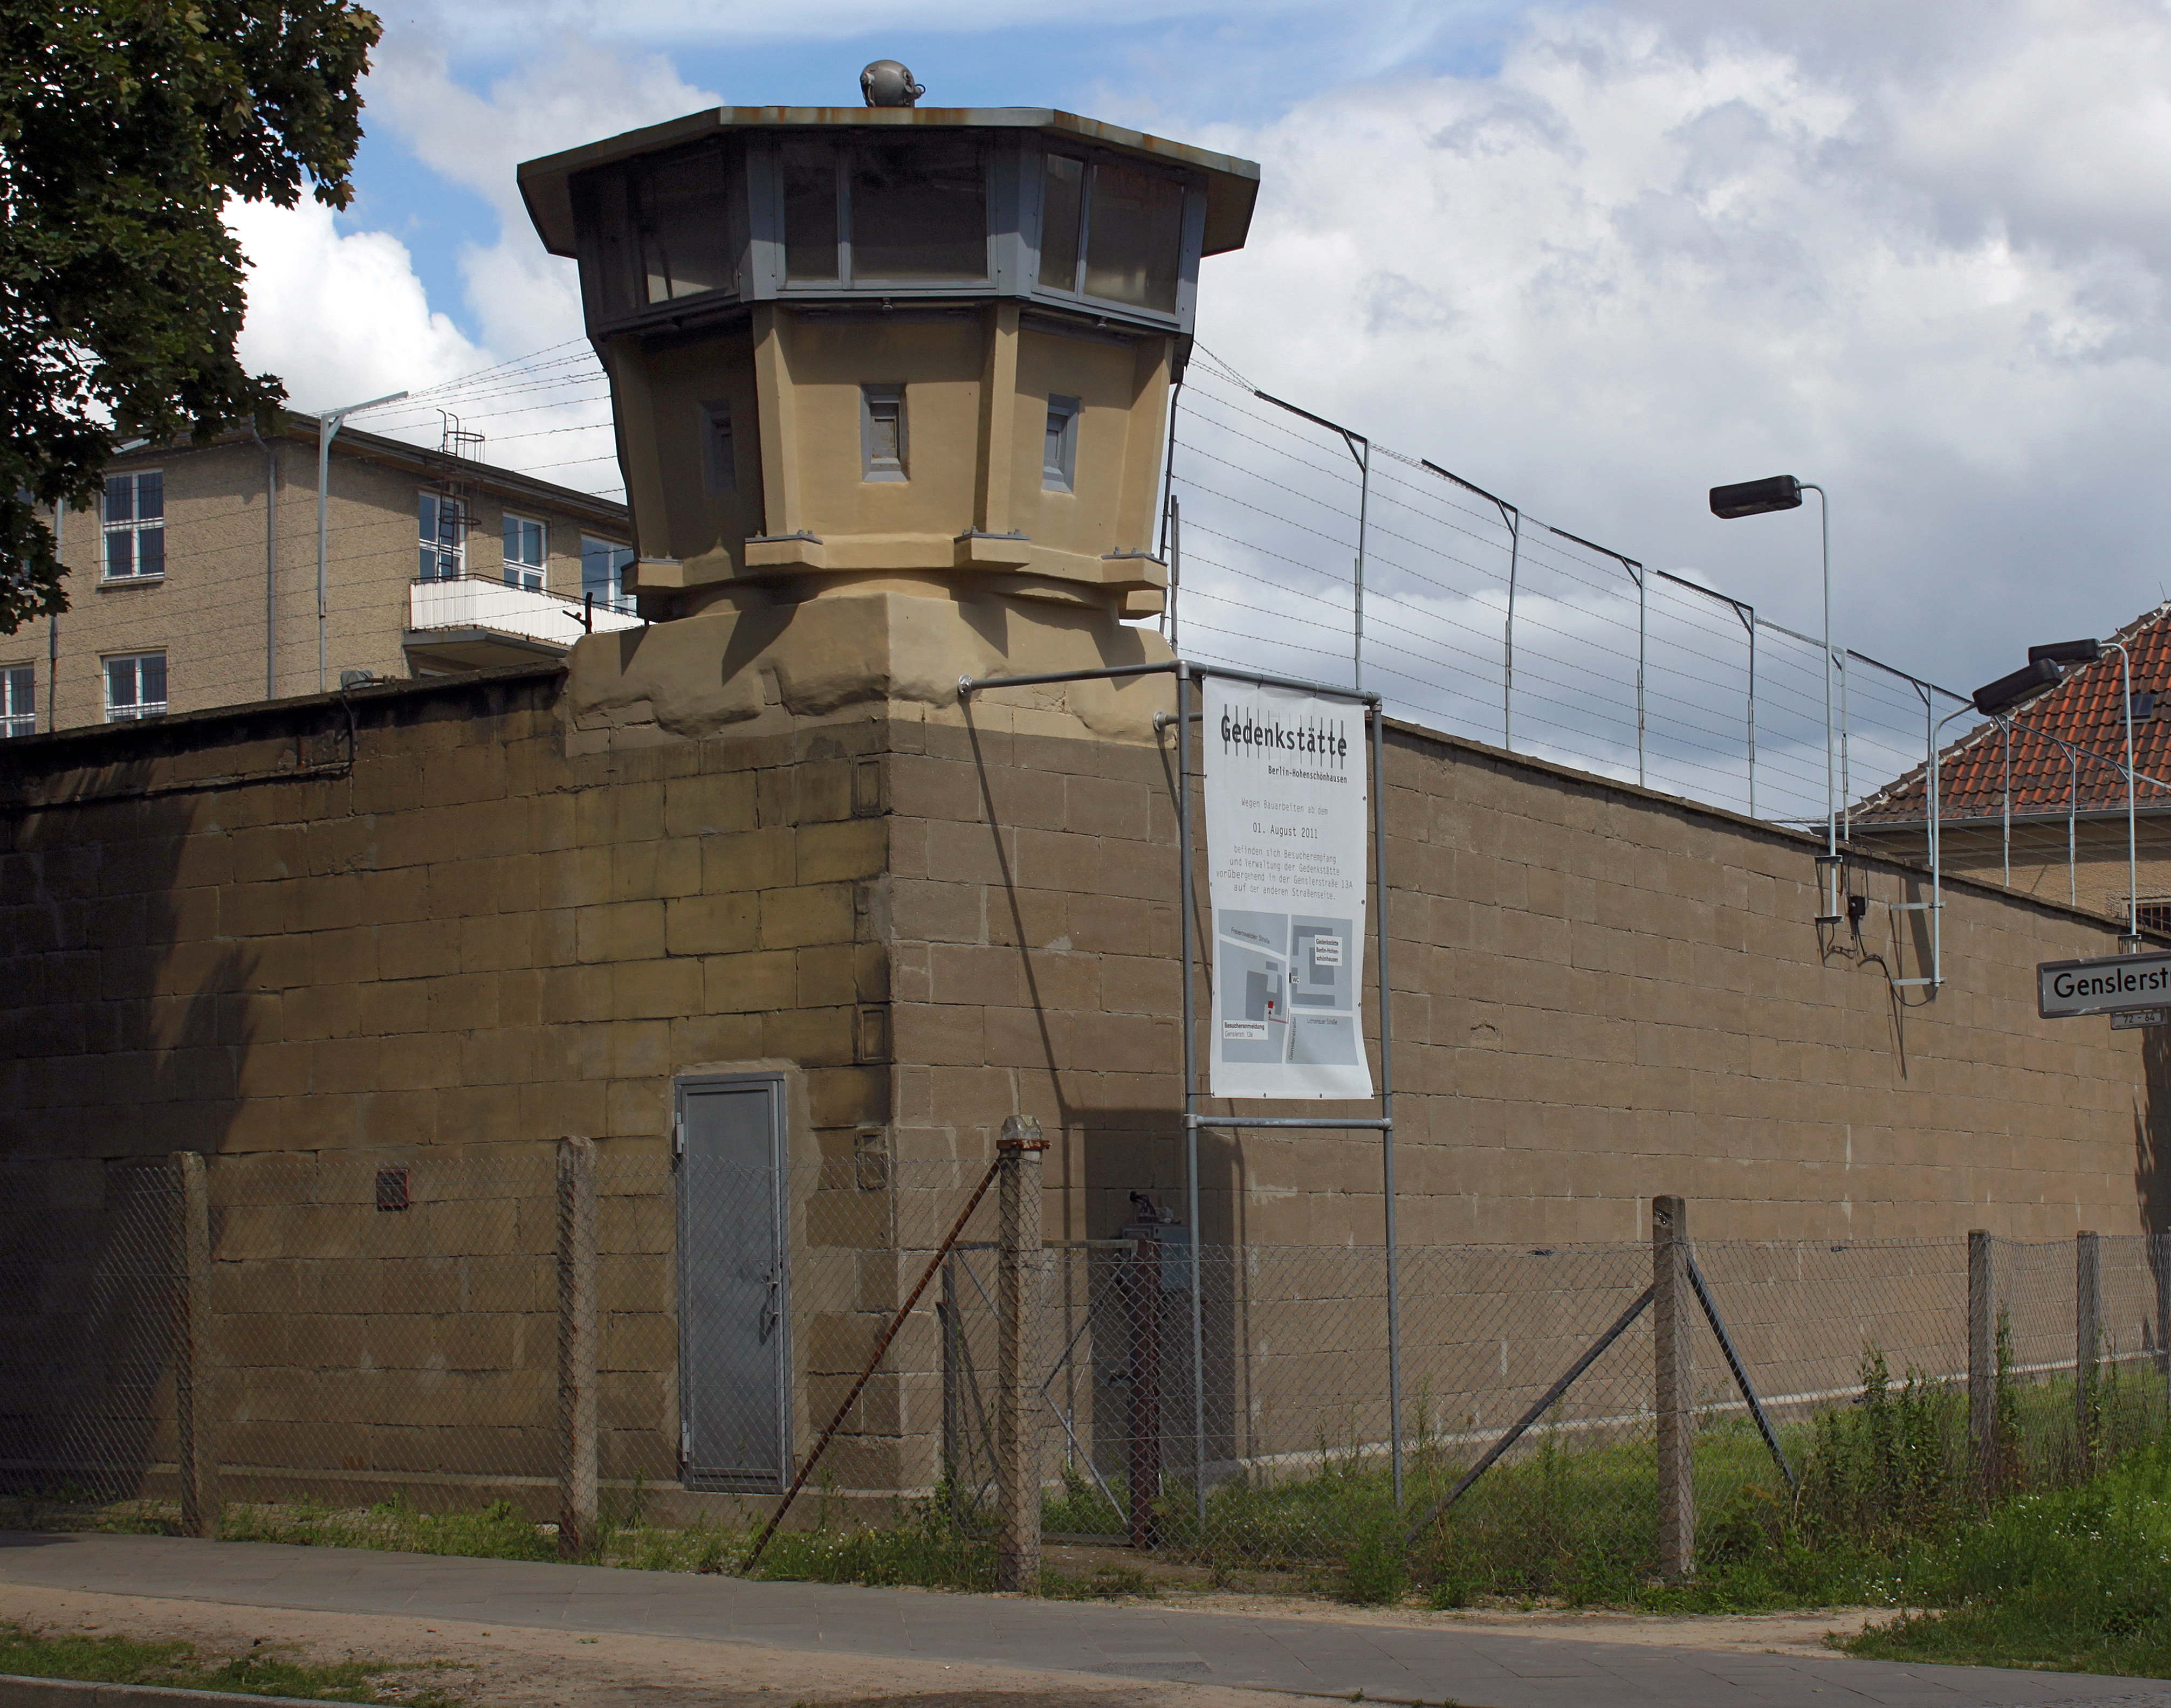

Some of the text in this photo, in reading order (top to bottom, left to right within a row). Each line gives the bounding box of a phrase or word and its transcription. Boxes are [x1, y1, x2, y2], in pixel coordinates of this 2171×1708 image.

[1221, 715, 1347, 757] Gedenkstätte
[1268, 765, 1348, 784] Berlin-Hohenschönhausen
[1241, 797, 1328, 815] Wegen Bauarbeiten ab dem
[1253, 822, 1318, 839] 01. August 2011
[1234, 844, 1337, 865] befinden sich Besucherempfang
[1229, 858, 1340, 876] und Verwaltung der Gedenkstätte
[1216, 870, 1354, 890] vorübergehend in der Genslerstraße 13A
[1234, 883, 1247, 892] auf
[1249, 885, 1260, 893] der
[1263, 887, 1289, 896] anderen
[2053, 967, 2171, 998] Genslerst
[1224, 1022, 1265, 1030] Besucheranmeldung
[2124, 1015, 2133, 1023] 72
[2145, 1014, 2155, 1022] 64
